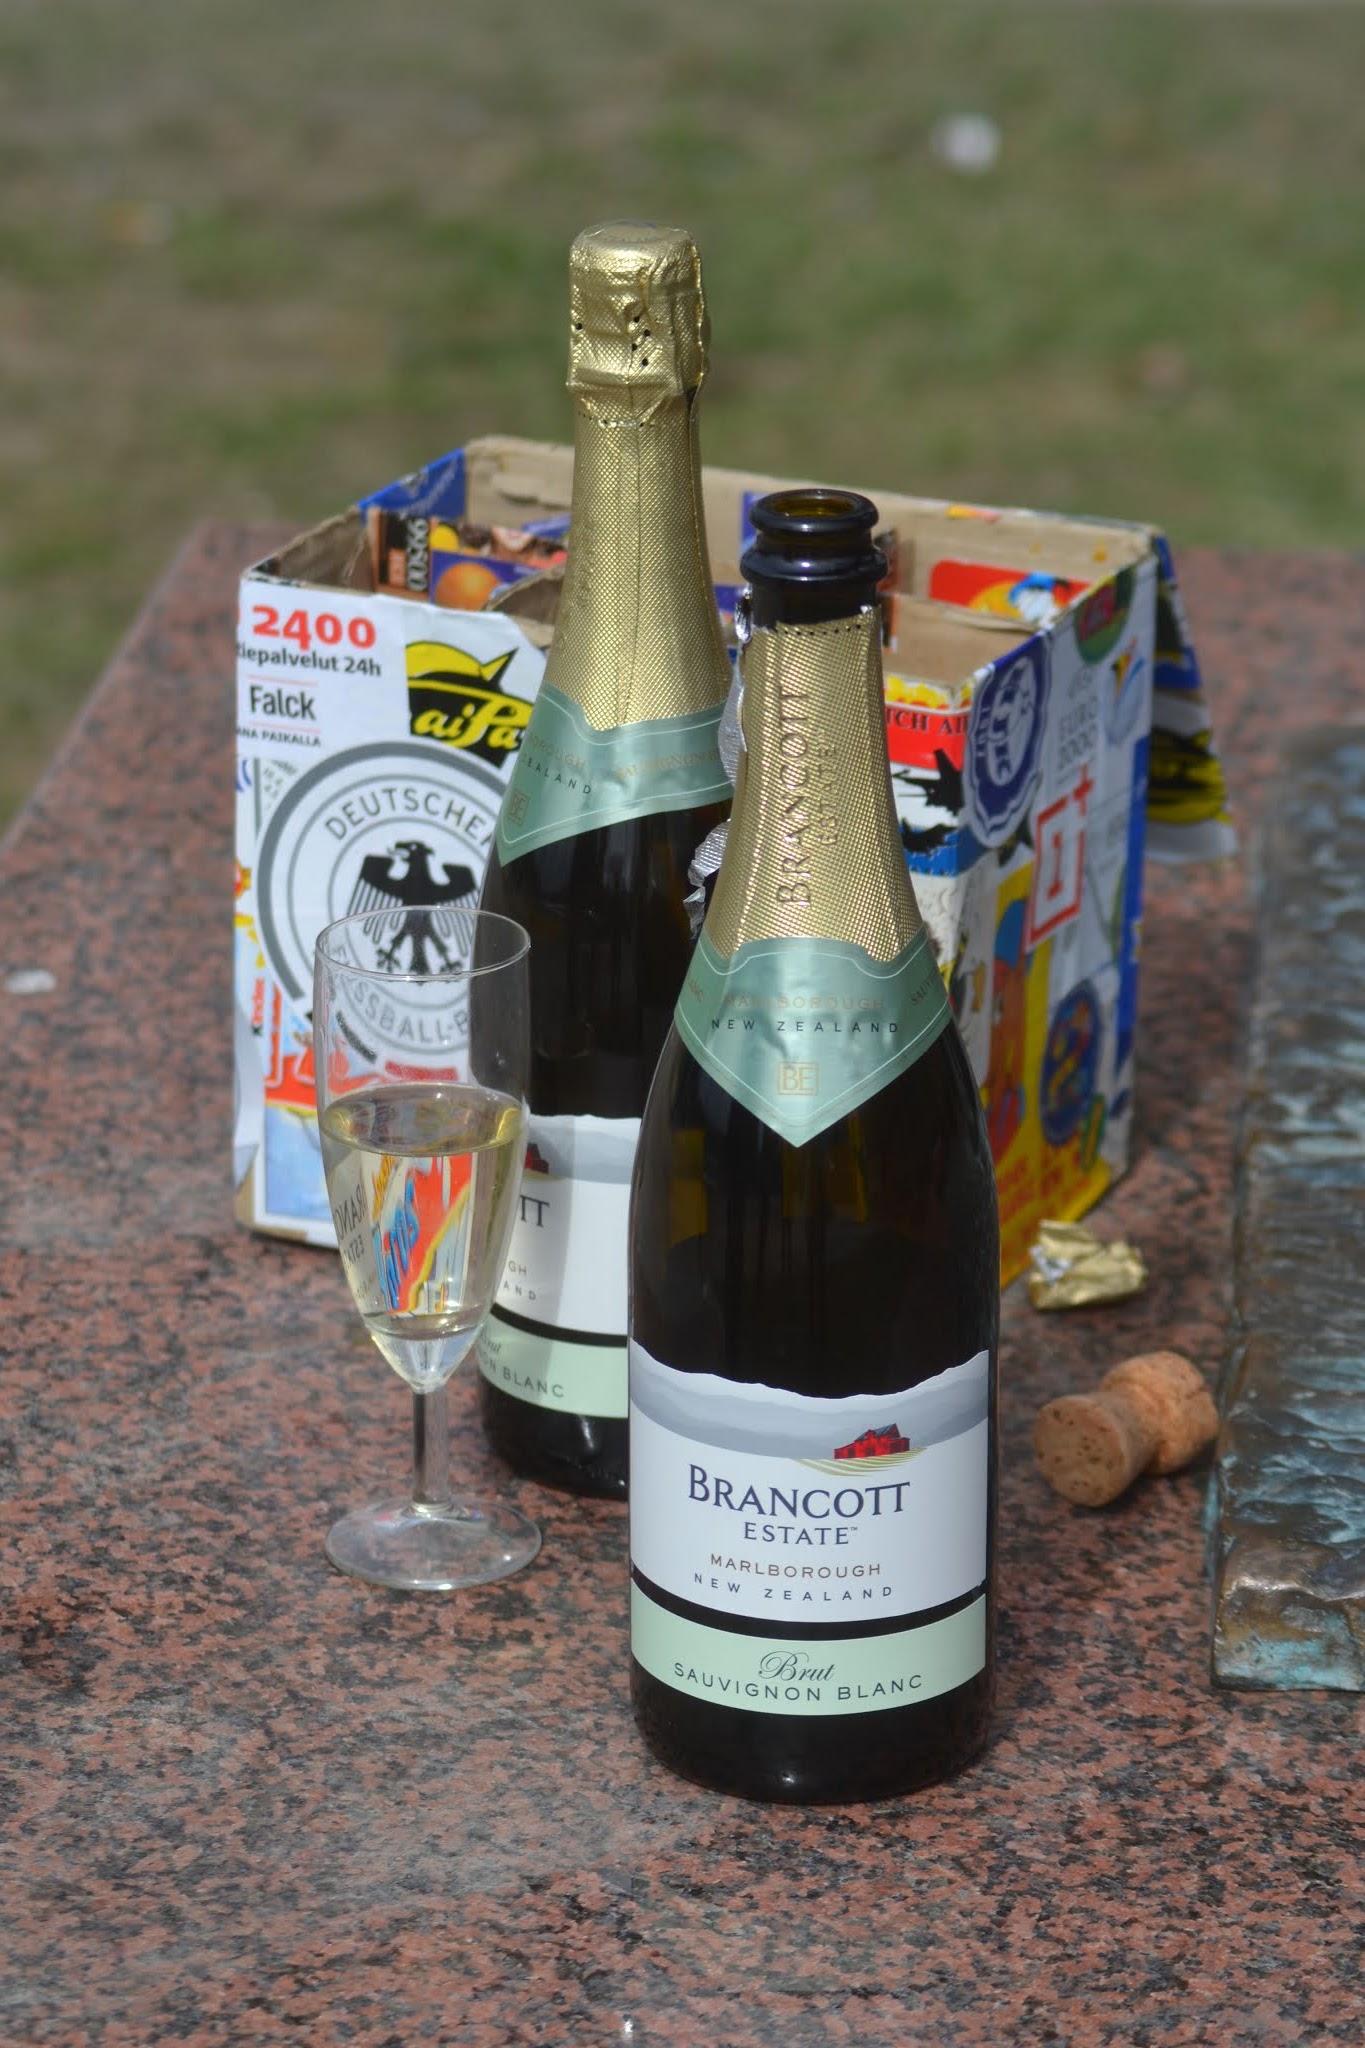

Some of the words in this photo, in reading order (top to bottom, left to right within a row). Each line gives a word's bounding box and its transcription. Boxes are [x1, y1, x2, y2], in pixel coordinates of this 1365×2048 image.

[252, 605, 376, 652] 2400
[343, 656, 382, 678] 24h
[249, 684, 316, 721] Falck
[775, 684, 813, 908] BRANCOTT
[325, 787, 493, 845] DEUTSCHE
[711, 1018, 756, 1030] NEW
[776, 1020, 898, 1033] ZEALAND
[502, 1365, 565, 1399] BLANC
[688, 1463, 912, 1520] BRANCOTT
[710, 1552, 882, 1578] MARLBOROUGH
[694, 1571, 742, 1594] NEW
[763, 1585, 893, 1602] ZEALAND
[673, 1661, 822, 1702] SAUVIGNON
[836, 1674, 924, 1701] BLANC
[757, 1650, 838, 1682] Brut
